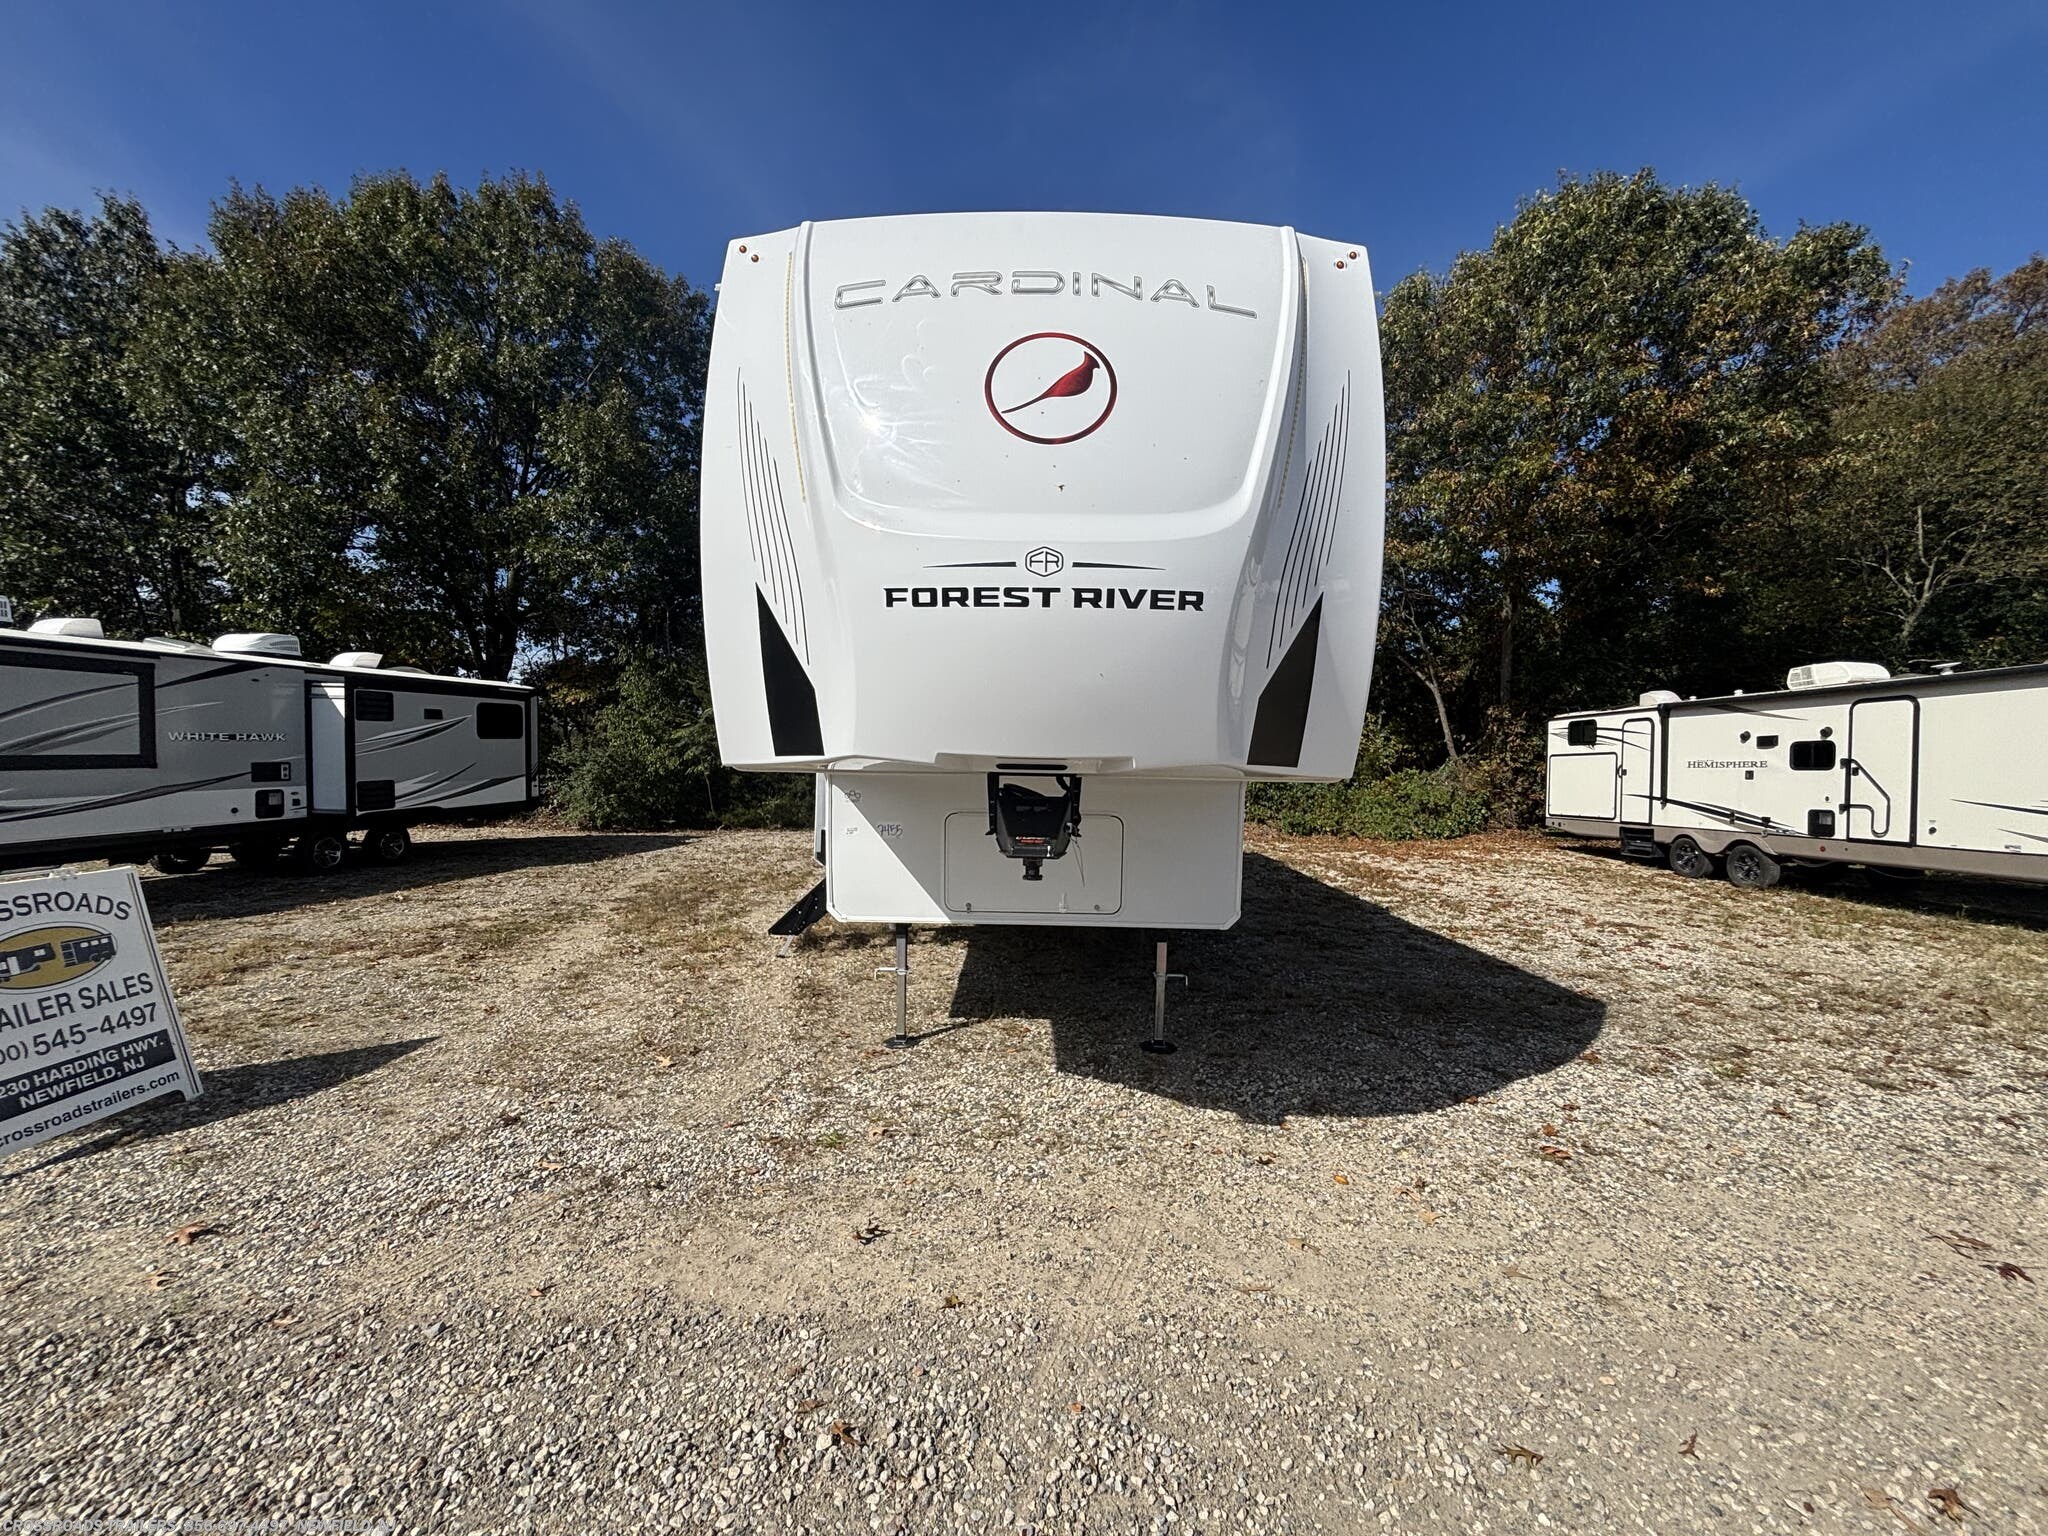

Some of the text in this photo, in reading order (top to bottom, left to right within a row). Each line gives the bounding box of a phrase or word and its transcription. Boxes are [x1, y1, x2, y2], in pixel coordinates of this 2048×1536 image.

[834, 270, 1256, 318] CARDINAL
[884, 587, 1204, 611] FOREST RIVER
[168, 731, 286, 741] WHITE HAWK
[1687, 760, 1768, 769] HEMISPHERE
[78, 972, 154, 1010] SALES
[33, 1002, 157, 1056] 545-4497
[19, 1056, 146, 1109] NEWFIELD, NJ
[34, 1050, 120, 1087] HARDING
[122, 1036, 164, 1057] HWY.
